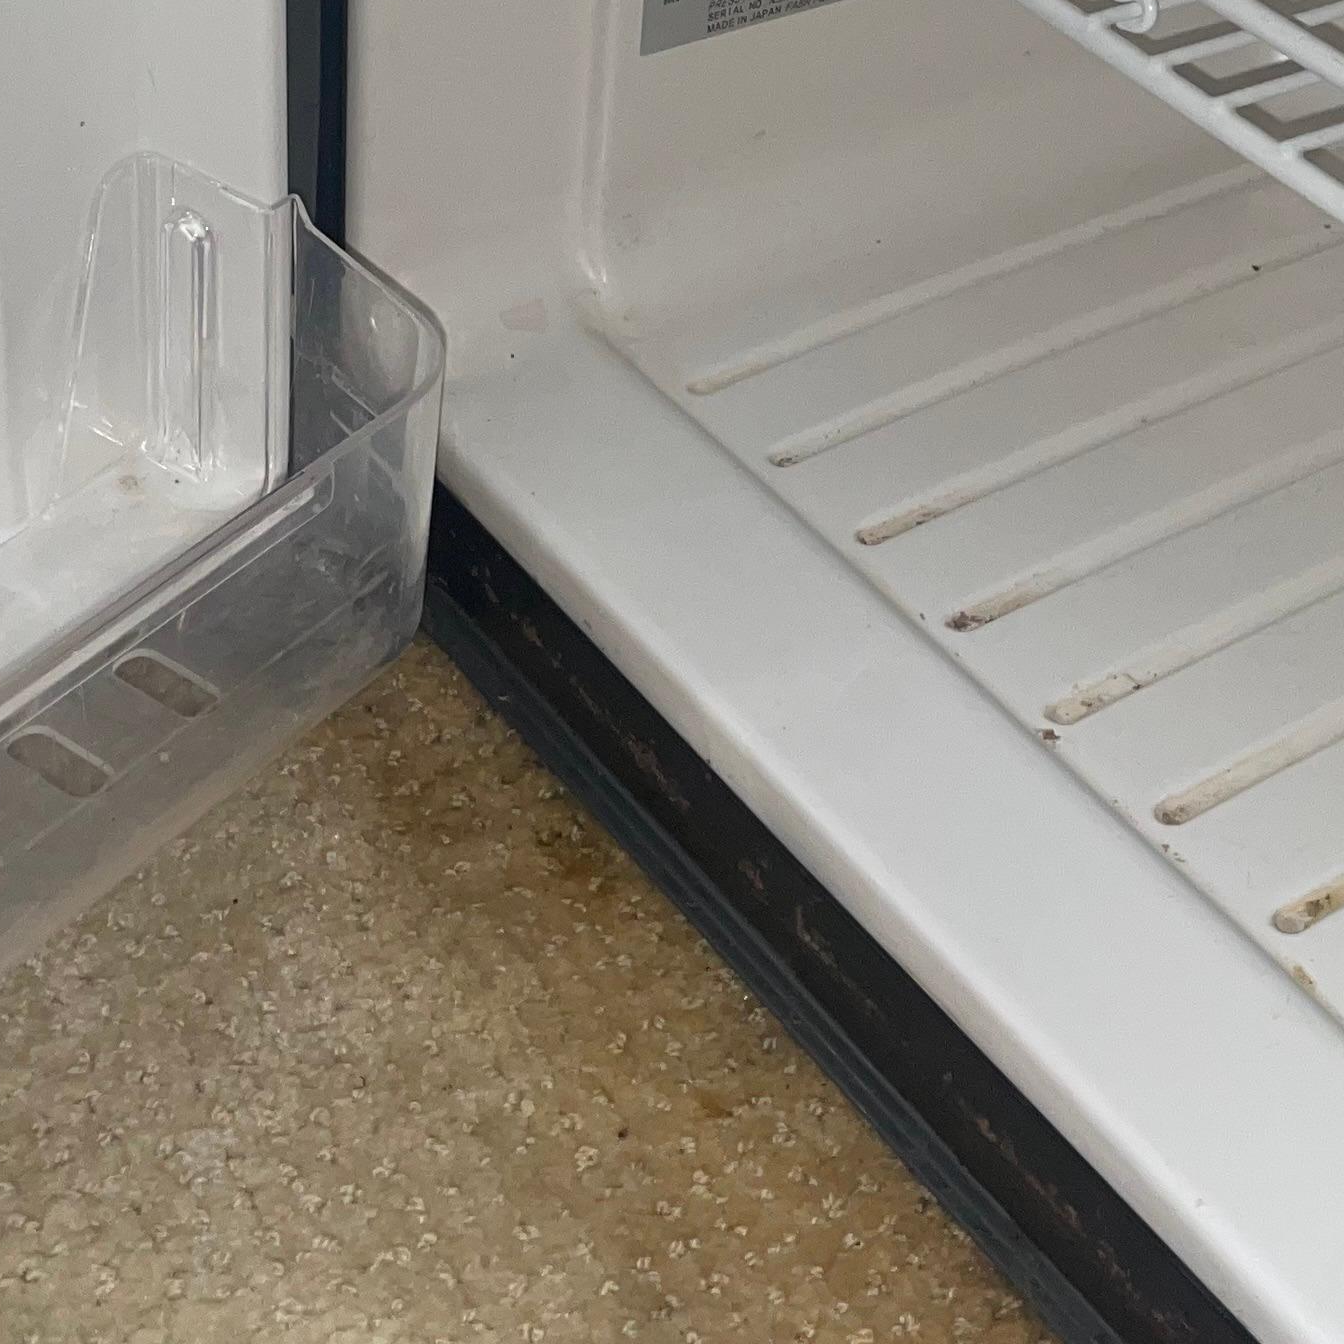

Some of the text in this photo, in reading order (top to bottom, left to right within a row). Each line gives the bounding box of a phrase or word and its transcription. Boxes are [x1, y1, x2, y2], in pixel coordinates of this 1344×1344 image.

[707, 5, 781, 33] MADE IN JAPAN
[708, 0, 761, 21] SERIAL NO
